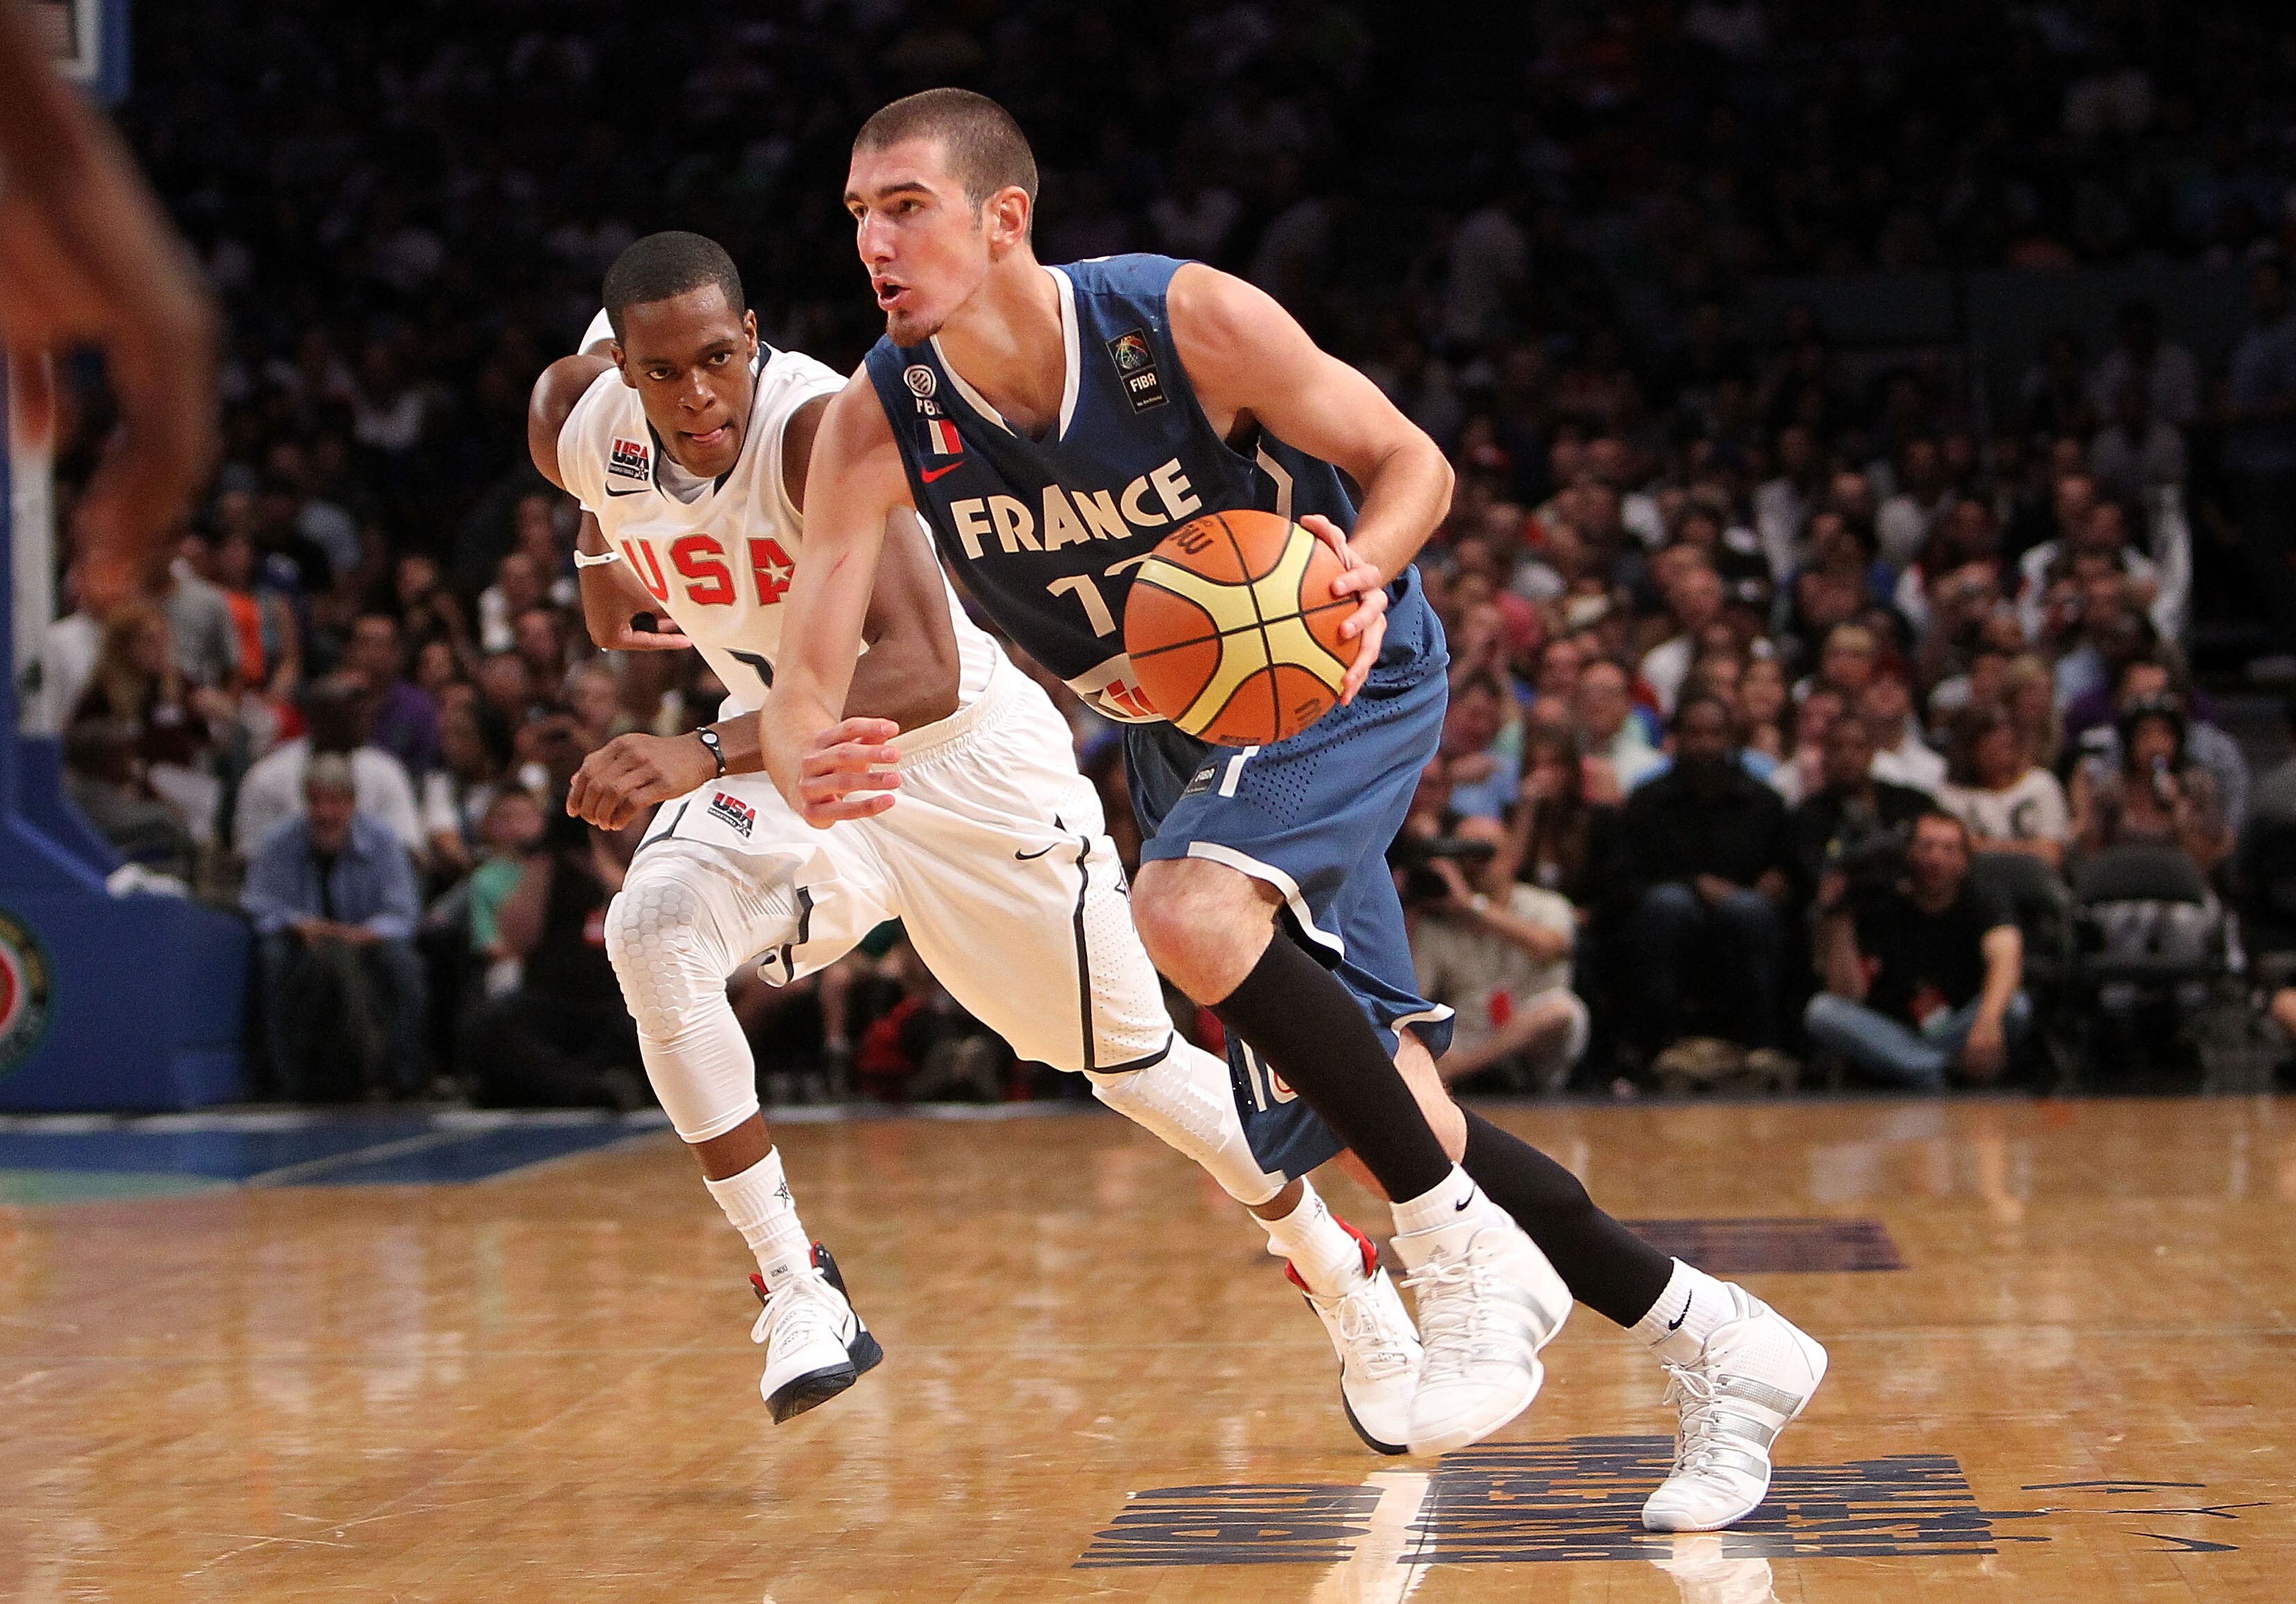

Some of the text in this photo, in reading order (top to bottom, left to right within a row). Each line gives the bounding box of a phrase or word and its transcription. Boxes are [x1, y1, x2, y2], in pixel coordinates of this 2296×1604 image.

[1130, 373, 1156, 393] FIBA
[613, 440, 649, 481] USA
[950, 458, 1203, 560] FRANCE
[620, 533, 796, 607] USA
[1047, 553, 1151, 637] 1
[713, 792, 756, 837] USA
